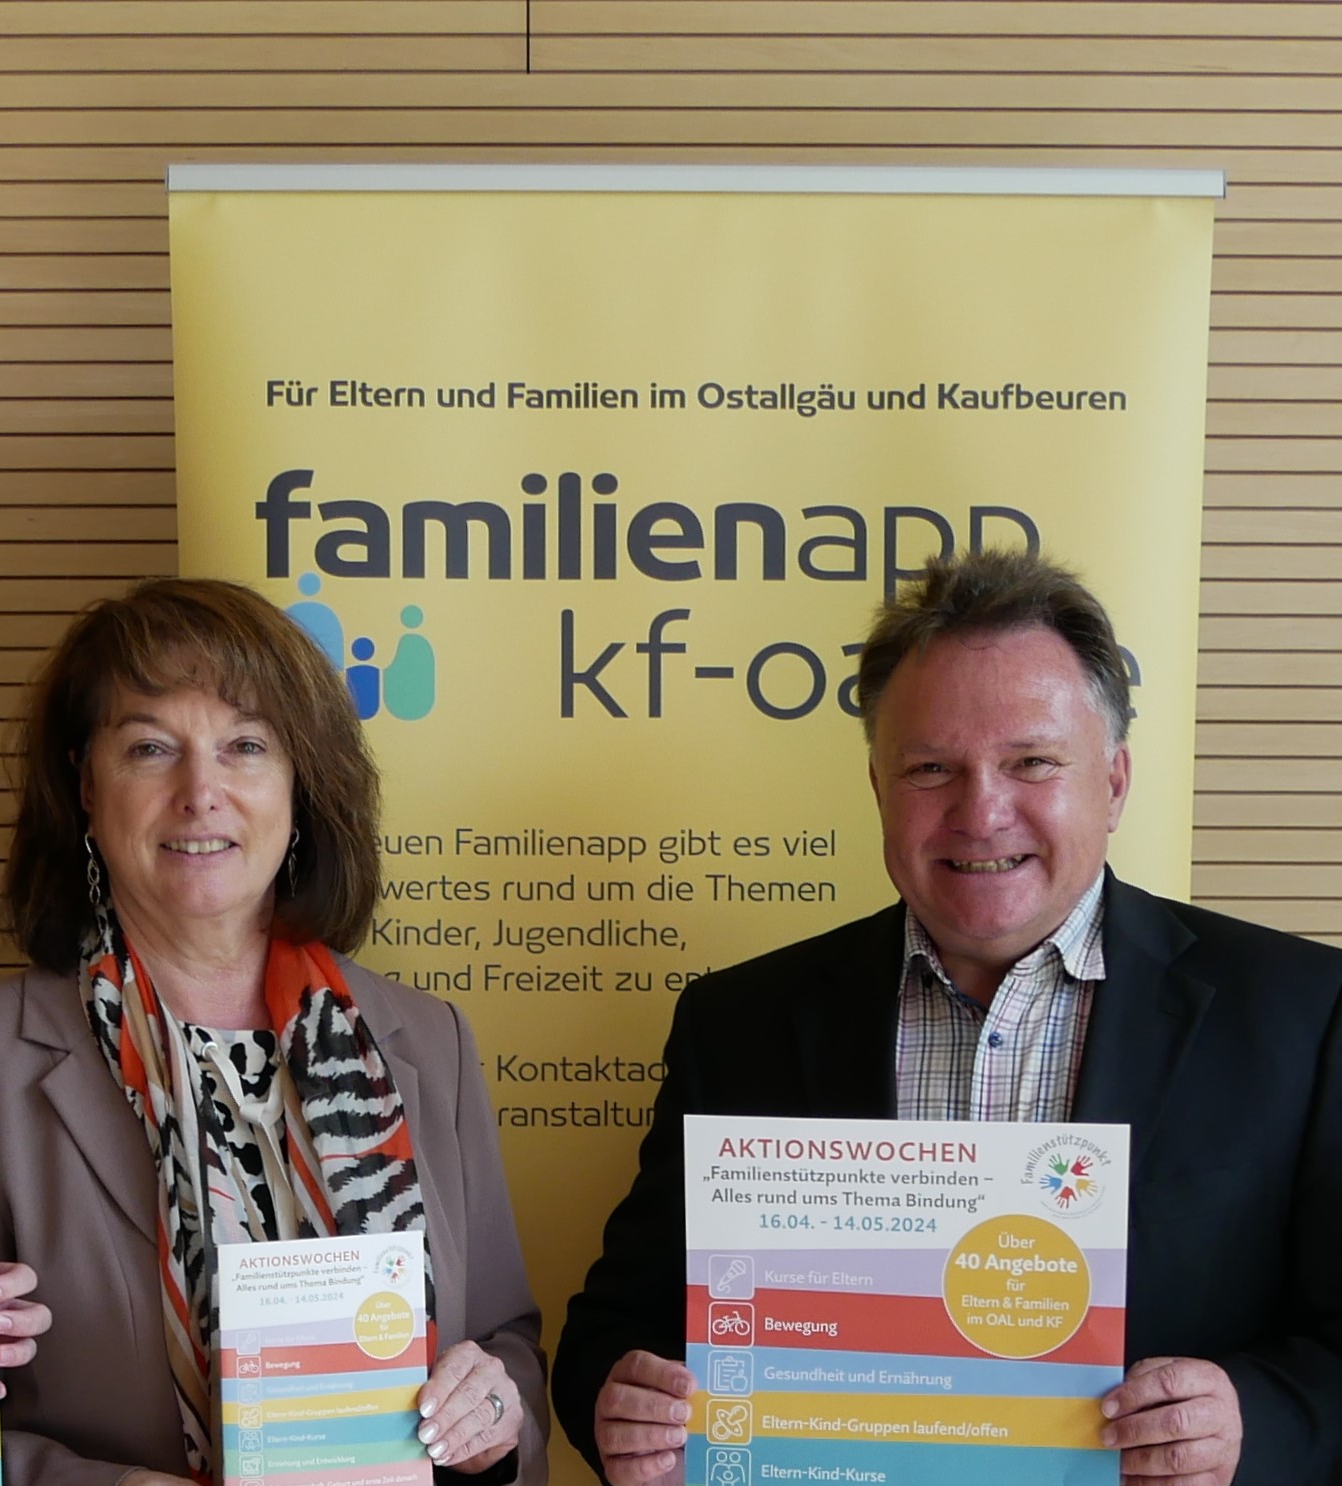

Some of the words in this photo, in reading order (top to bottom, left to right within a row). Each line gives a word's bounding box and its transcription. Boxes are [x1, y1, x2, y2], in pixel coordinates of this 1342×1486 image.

[267, 380, 318, 407] Für
[329, 380, 425, 407] Eltern
[437, 382, 495, 408] und
[507, 382, 639, 409] Familien
[650, 383, 686, 409] im
[697, 382, 856, 417] Ostallgäu
[867, 384, 926, 410] und
[938, 383, 1127, 411] Kaufbeuren
[373, 834, 442, 855] euen
[455, 829, 647, 863] Familienapp
[659, 830, 722, 864] gibt
[732, 837, 771, 857] es
[782, 830, 837, 857] viel
[380, 875, 491, 902] wertes
[503, 875, 575, 902] rund
[587, 881, 635, 902] um
[647, 875, 695, 902] die
[705, 875, 838, 903] Themen
[372, 918, 481, 951] Kinder,
[493, 919, 687, 954] Jugendliche,
[414, 964, 471, 991] und
[484, 965, 603, 992] Freizeit
[615, 971, 652, 992] zu
[496, 1056, 666, 1083] Kontaktad
[719, 1137, 977, 1163] AKTIONSWOCHEN
[1020, 1133, 1112, 1185] Familienstützpunkt
[890, 1169, 978, 1187] verbinden
[711, 1187, 751, 1204] Alles
[757, 1189, 797, 1205] rund
[802, 1192, 838, 1207] ums
[842, 1191, 900, 1208] Thema
[759, 1213, 815, 1230] 16.04.
[833, 1214, 937, 1234] 14.05.2024
[998, 1232, 1036, 1250] Über
[239, 1250, 360, 1270] AKTIONSWOCHEN
[956, 1252, 981, 1271] 40
[985, 1255, 1078, 1276] Angebote
[764, 1269, 805, 1286] Kurse
[808, 1270, 828, 1286] für
[832, 1271, 874, 1287] Eltern
[1006, 1278, 1026, 1292] für
[961, 1294, 1000, 1310] Eltern
[1015, 1297, 1070, 1313] Familien
[764, 1318, 838, 1337] Bewegung
[967, 1312, 982, 1327] im
[986, 1313, 1015, 1328] OAL
[1017, 1314, 1043, 1329] und
[1046, 1315, 1064, 1330] KF
[764, 1366, 845, 1383] Gesundheit
[848, 1368, 875, 1384] und
[879, 1369, 953, 1390] Ernährung
[762, 1415, 910, 1437] Eltern-Kind-Gruppen
[913, 1417, 1008, 1438] laufend/offen
[761, 1464, 886, 1484] Eltern-Kind-Kurse
